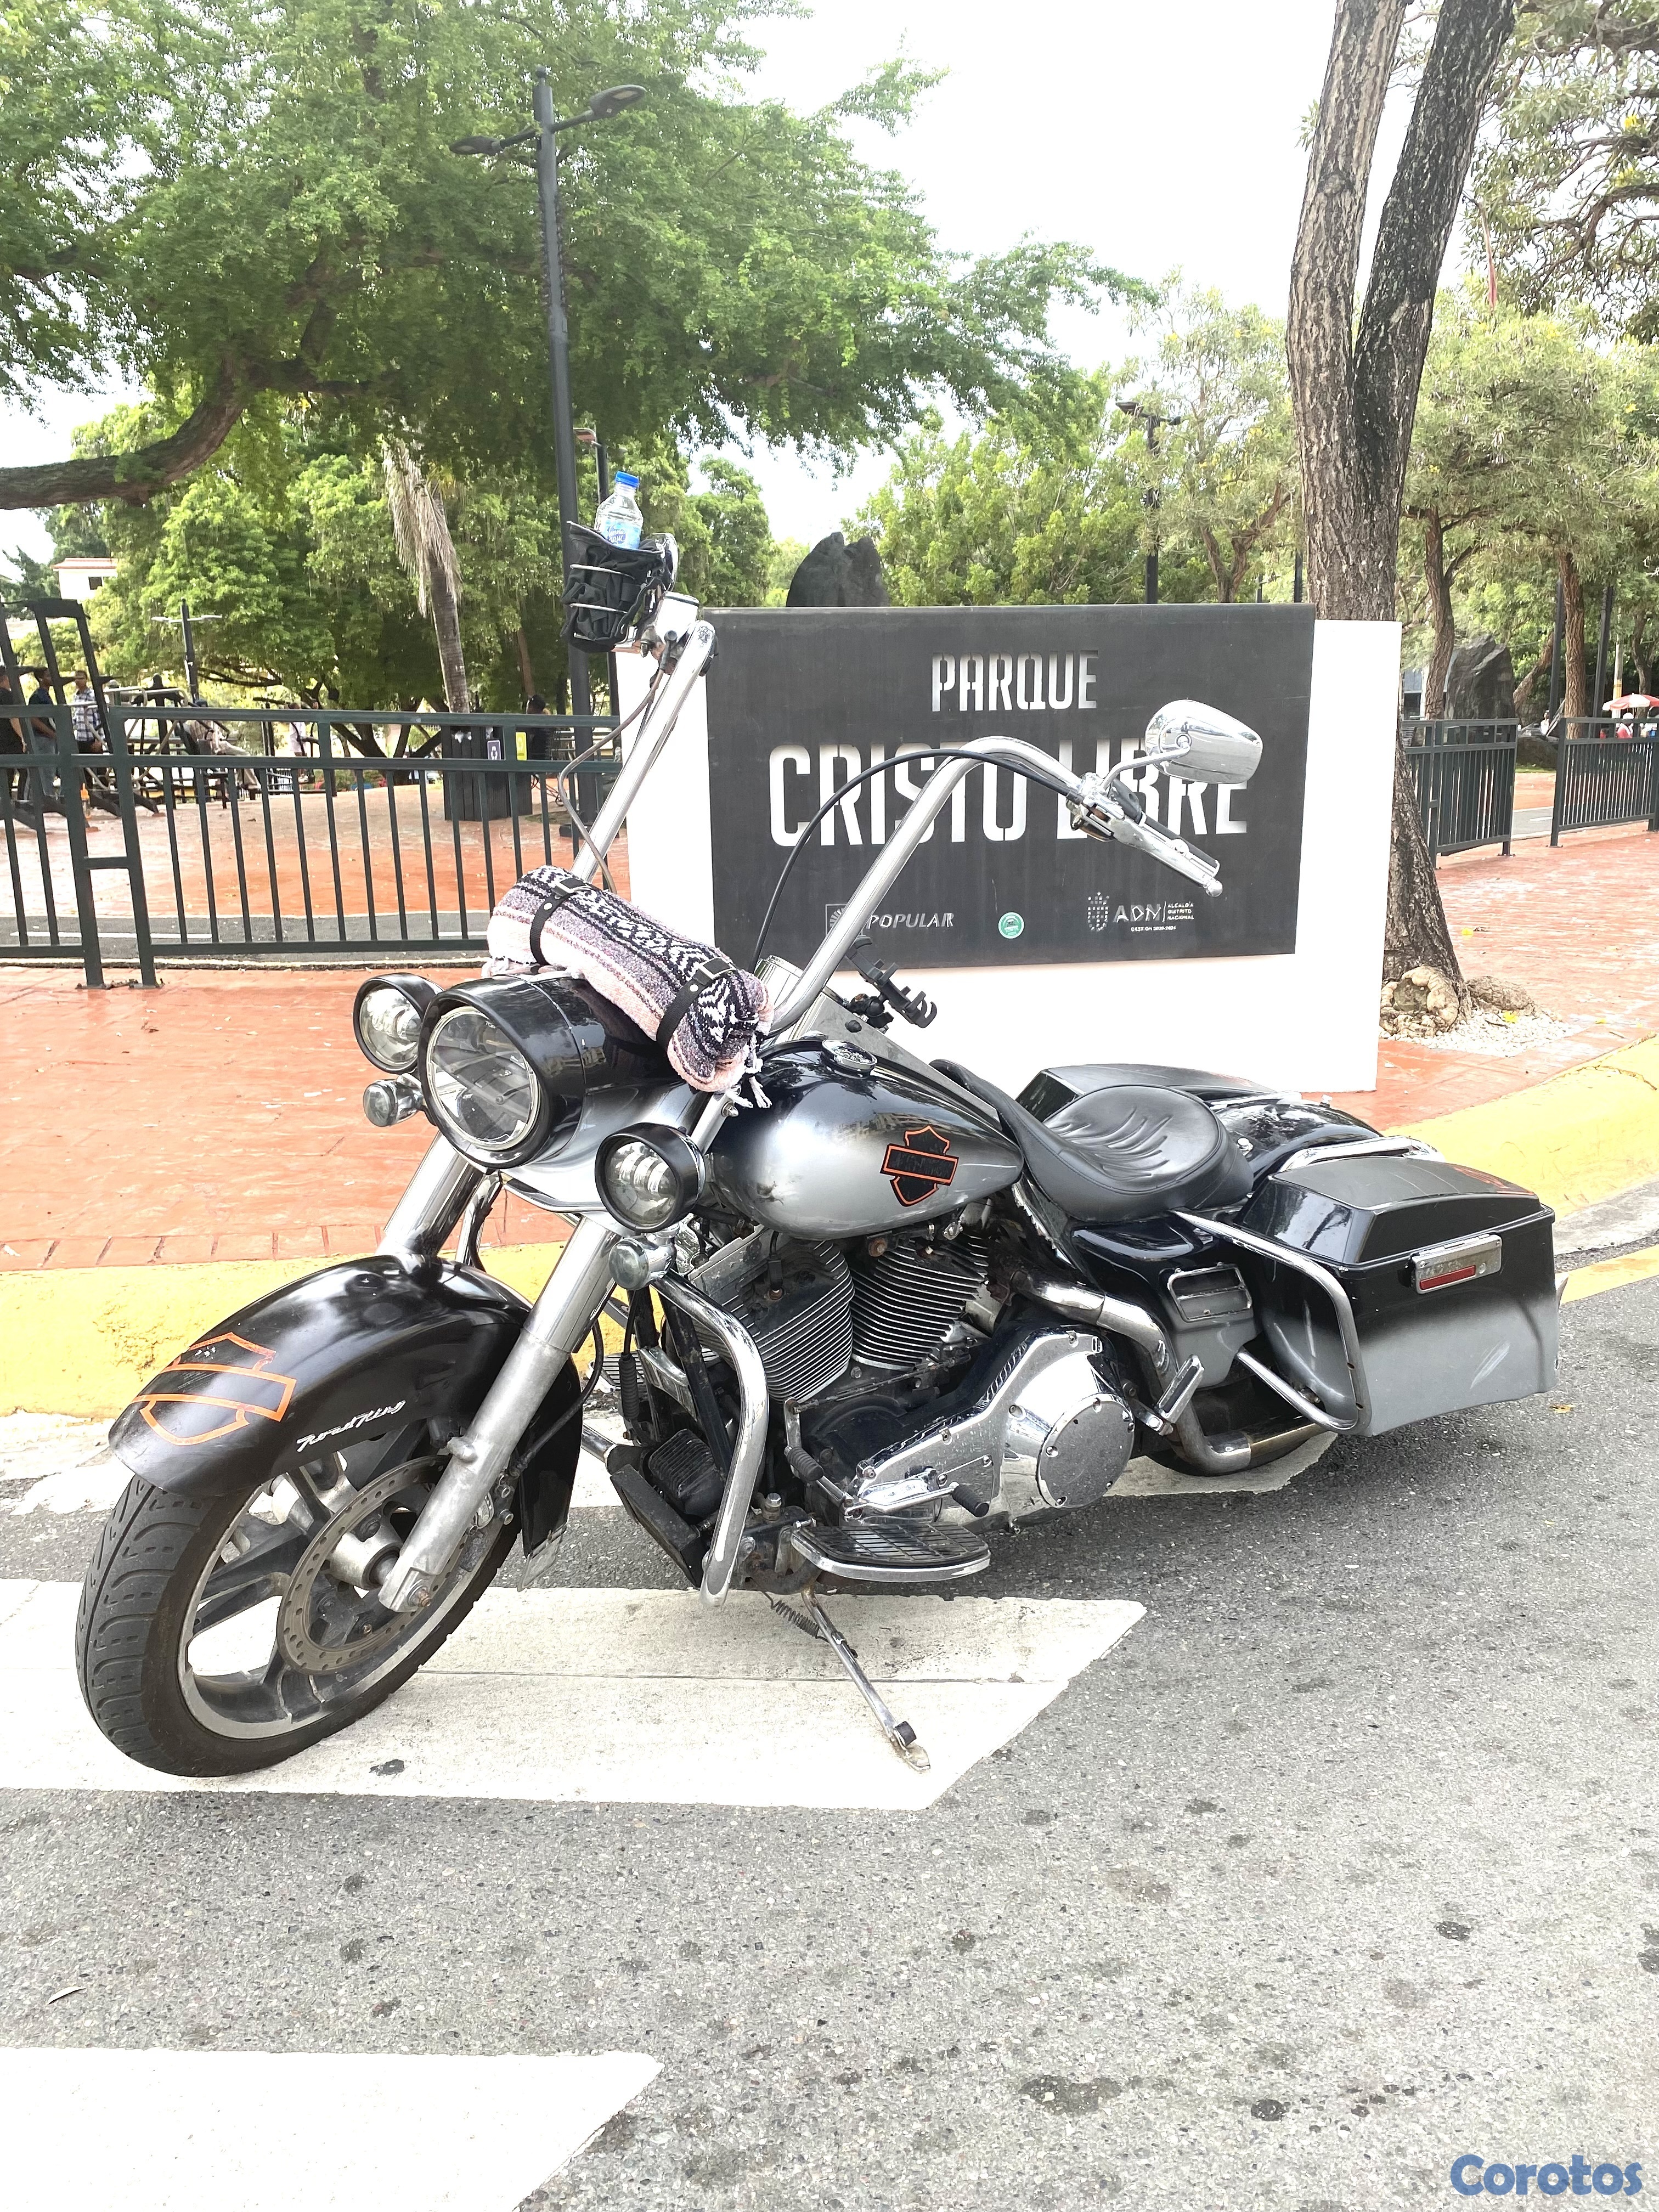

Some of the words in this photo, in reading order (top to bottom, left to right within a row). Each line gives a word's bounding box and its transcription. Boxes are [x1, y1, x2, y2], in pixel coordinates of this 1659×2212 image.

[932, 650, 1099, 712] PARQUE
[769, 742, 1027, 847] CRISTO
[866, 912, 955, 930] POPULAR
[1113, 904, 1161, 923] ADN
[296, 1416, 357, 1452] Road
[355, 1400, 406, 1428] King
